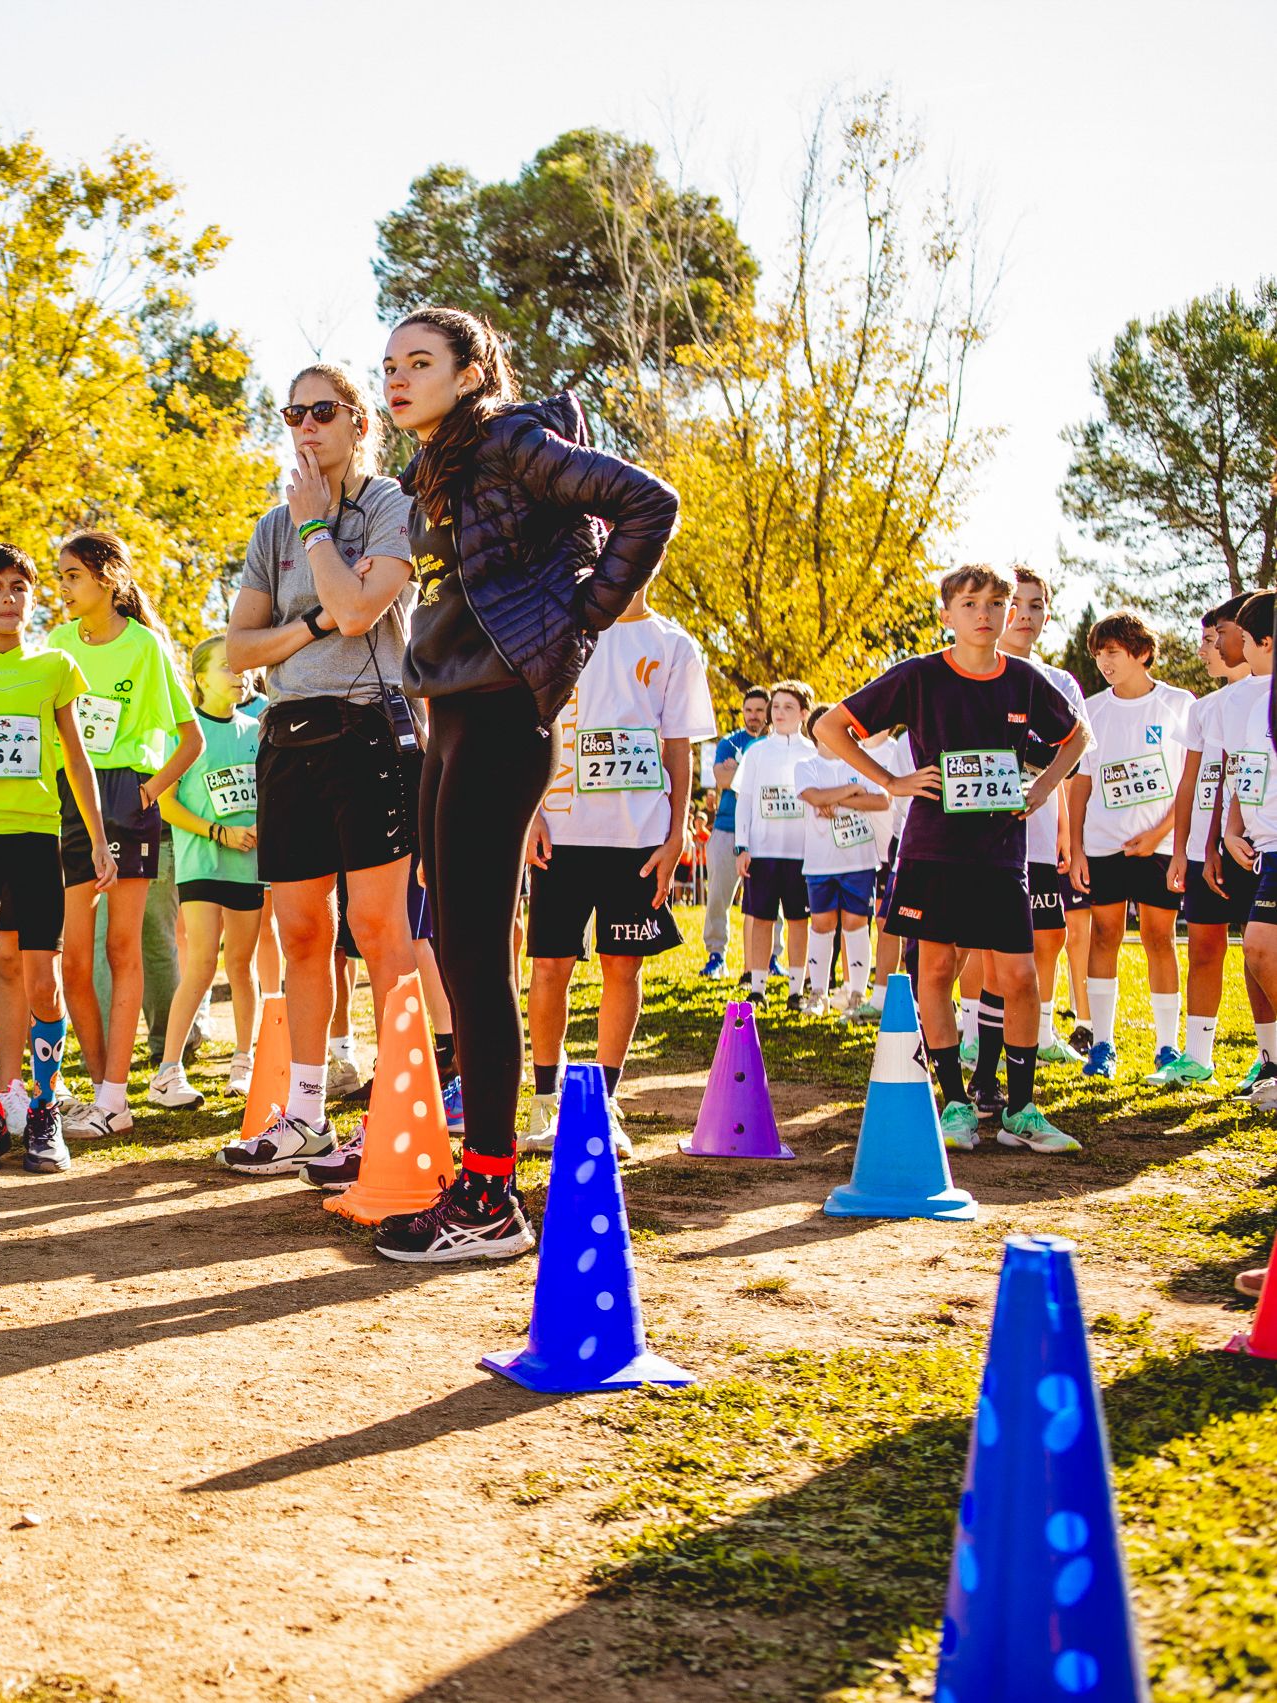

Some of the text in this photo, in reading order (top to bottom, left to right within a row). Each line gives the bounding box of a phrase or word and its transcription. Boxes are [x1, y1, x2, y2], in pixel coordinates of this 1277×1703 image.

[83, 725, 96, 740] 6
[582, 741, 613, 753] CROS
[589, 760, 649, 778] 2774
[948, 763, 980, 775] CROS
[209, 774, 234, 788] CROS
[1112, 778, 1158, 798] 3166
[219, 788, 257, 804] 1204
[956, 781, 1013, 799] 2784
